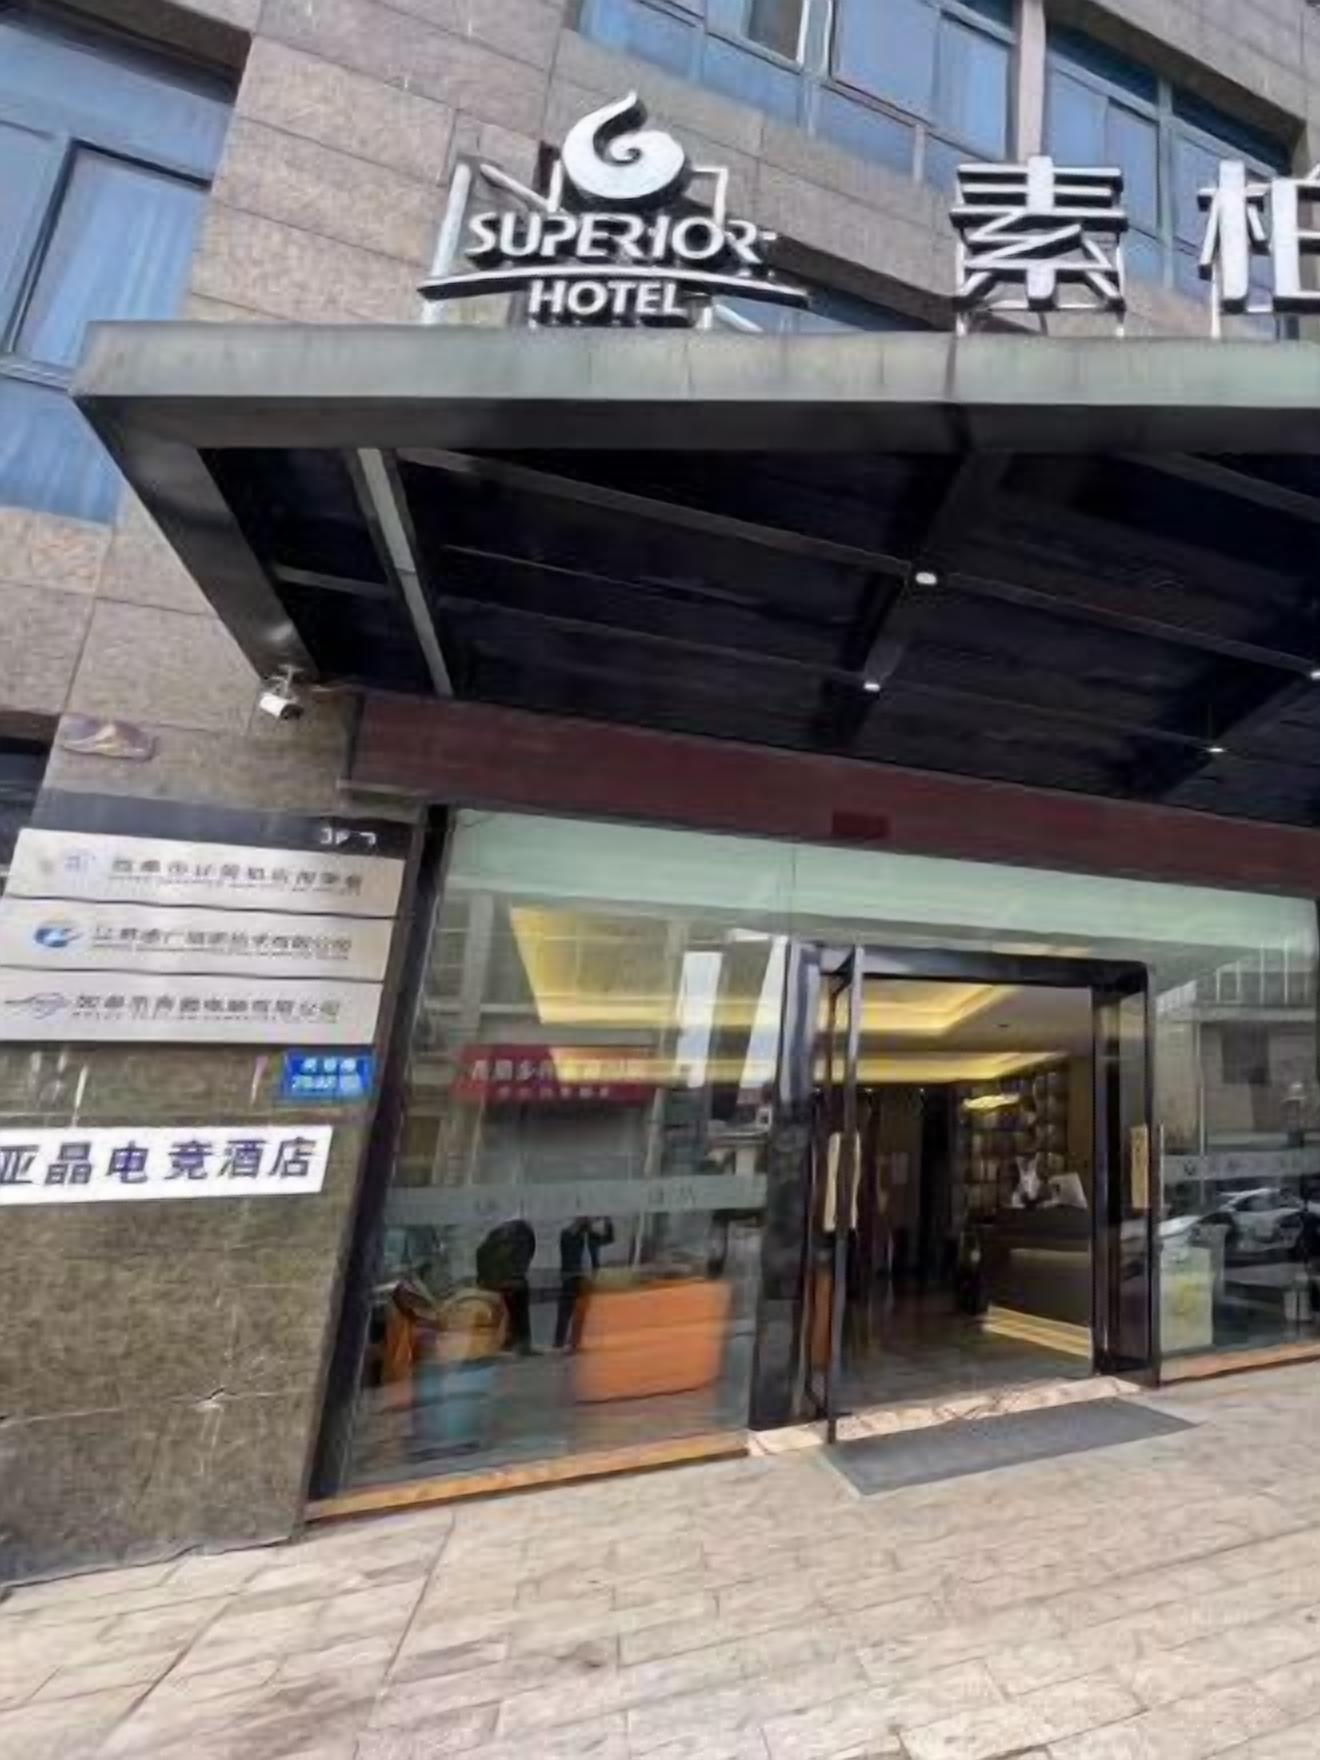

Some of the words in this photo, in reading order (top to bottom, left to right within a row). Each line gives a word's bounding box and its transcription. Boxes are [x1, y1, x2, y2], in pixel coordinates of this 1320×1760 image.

[465, 211, 762, 264] SUPERIOR
[527, 278, 688, 317] HOTEL
[0, 1136, 317, 1186] 亚晶电竞酒店
